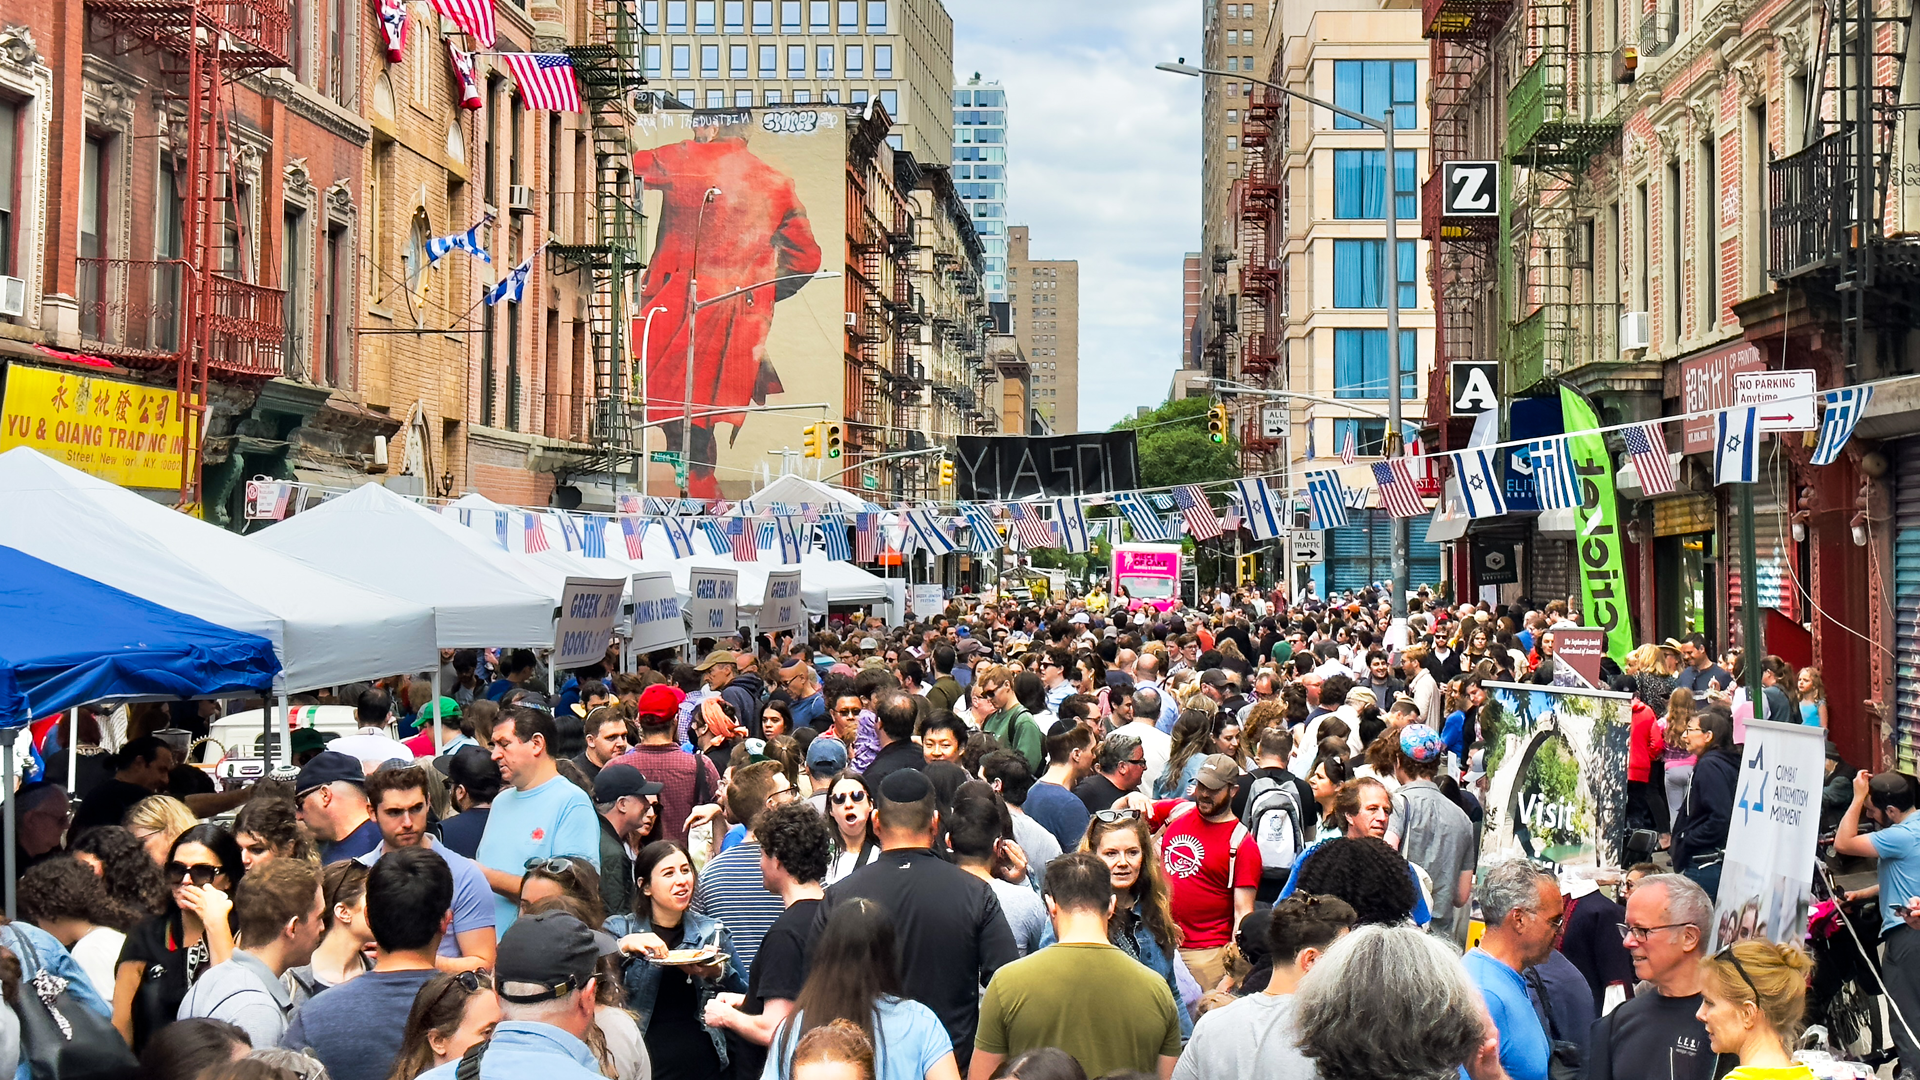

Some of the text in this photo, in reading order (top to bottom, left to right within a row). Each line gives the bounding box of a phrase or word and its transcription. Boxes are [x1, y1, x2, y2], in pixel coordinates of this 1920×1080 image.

[1452, 168, 1490, 210] Z
[1455, 367, 1498, 409] A
[1739, 377, 1796, 390] NO PARKING
[1741, 393, 1778, 403] Anytime
[8, 414, 191, 455] YU & QIANG TRADING IN
[100, 452, 118, 465] New
[1507, 479, 1535, 491] ELIT
[1298, 532, 1316, 540] ALL
[1575, 458, 1618, 632] cricket
[697, 579, 717, 599] GREEK
[771, 581, 788, 598] GREEK
[570, 594, 602, 618] GREEK
[634, 600, 655, 625] DRINKS
[778, 606, 791, 623] FOOD
[709, 609, 724, 628] FOOD
[562, 630, 592, 656] BOOKS
[1518, 791, 1575, 831] Visit
